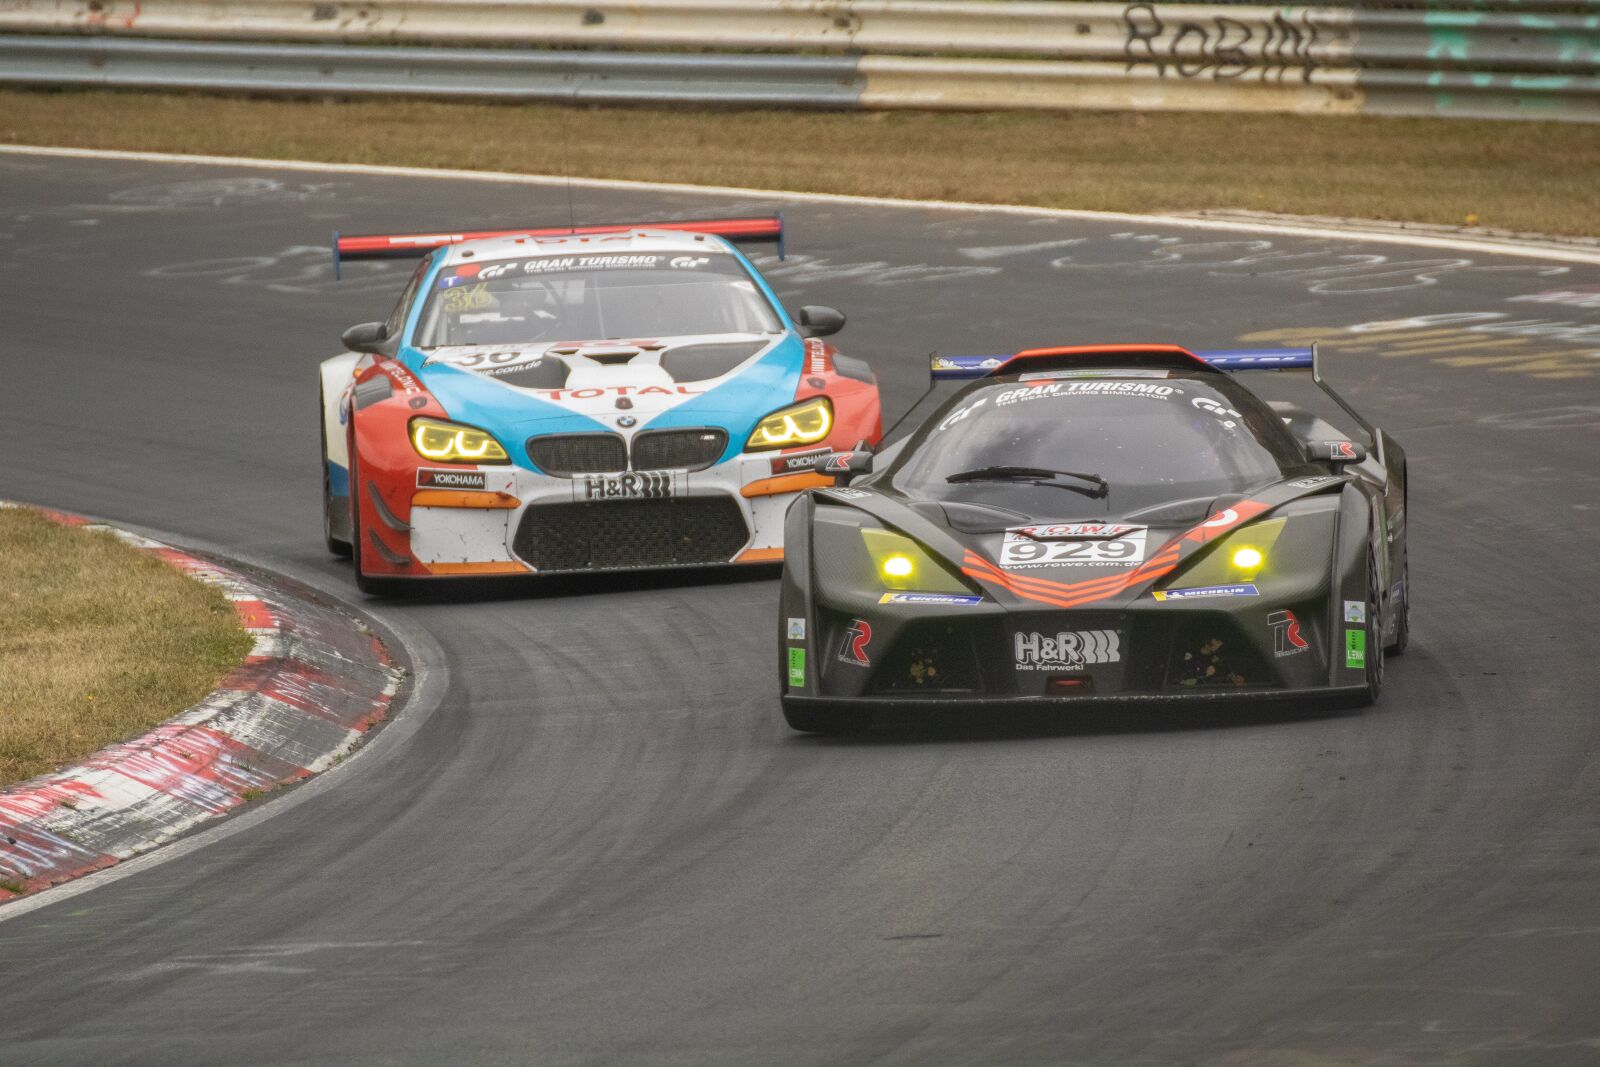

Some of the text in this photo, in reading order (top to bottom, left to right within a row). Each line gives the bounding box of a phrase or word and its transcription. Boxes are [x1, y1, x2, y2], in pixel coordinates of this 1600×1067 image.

[524, 255, 657, 271] GRAN TURISMO
[536, 385, 705, 401] TOTAL
[995, 382, 1174, 404] GRAN TURISMO
[1101, 390, 1168, 401] SIMULATOR
[786, 453, 823, 469] YOKOHA
[433, 473, 484, 486] YOKOHAMA
[584, 472, 643, 499] H&R
[1008, 540, 1138, 562] 929
[1000, 560, 1143, 570] www.rowe.com.de
[1184, 587, 1245, 596] MICHELIN
[1014, 631, 1085, 665] H&R
[1015, 663, 1034, 671] Das
